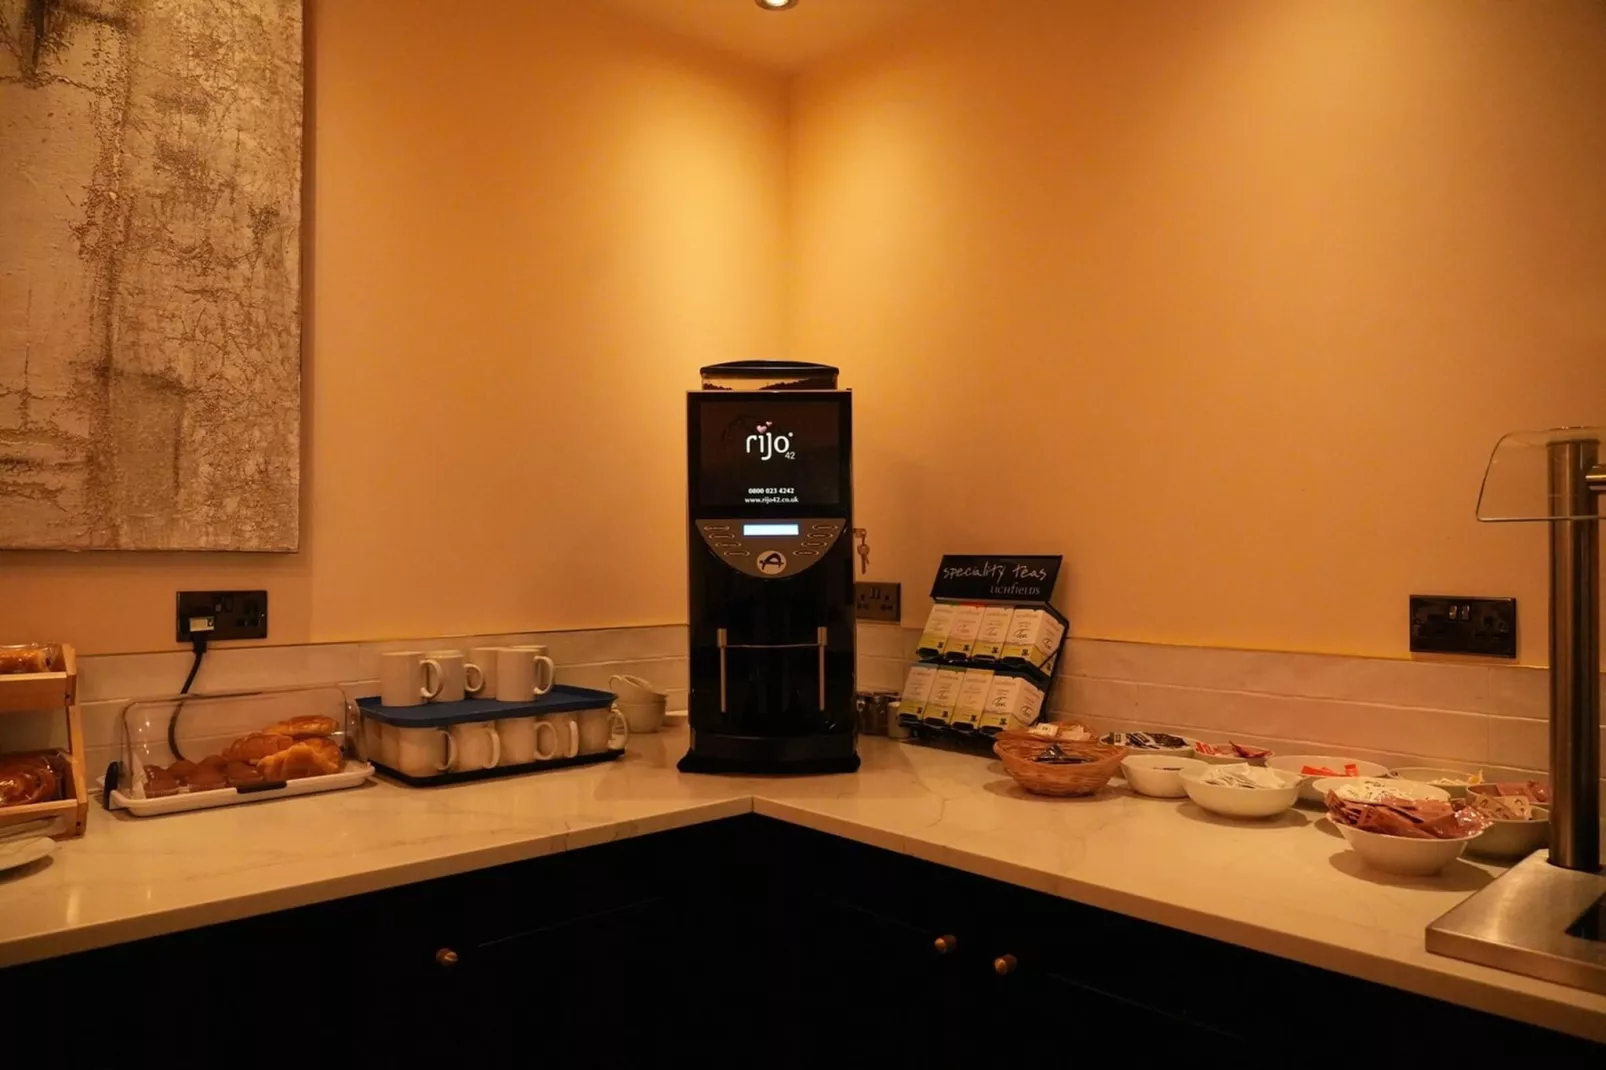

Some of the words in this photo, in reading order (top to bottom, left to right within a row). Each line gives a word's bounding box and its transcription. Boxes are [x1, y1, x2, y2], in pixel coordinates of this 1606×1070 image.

[746, 425, 791, 461] rijo
[784, 451, 796, 460] 42
[745, 496, 798, 504] www.rijo42.co.uk
[943, 561, 1005, 584] speciality
[1013, 563, 1047, 580] teas
